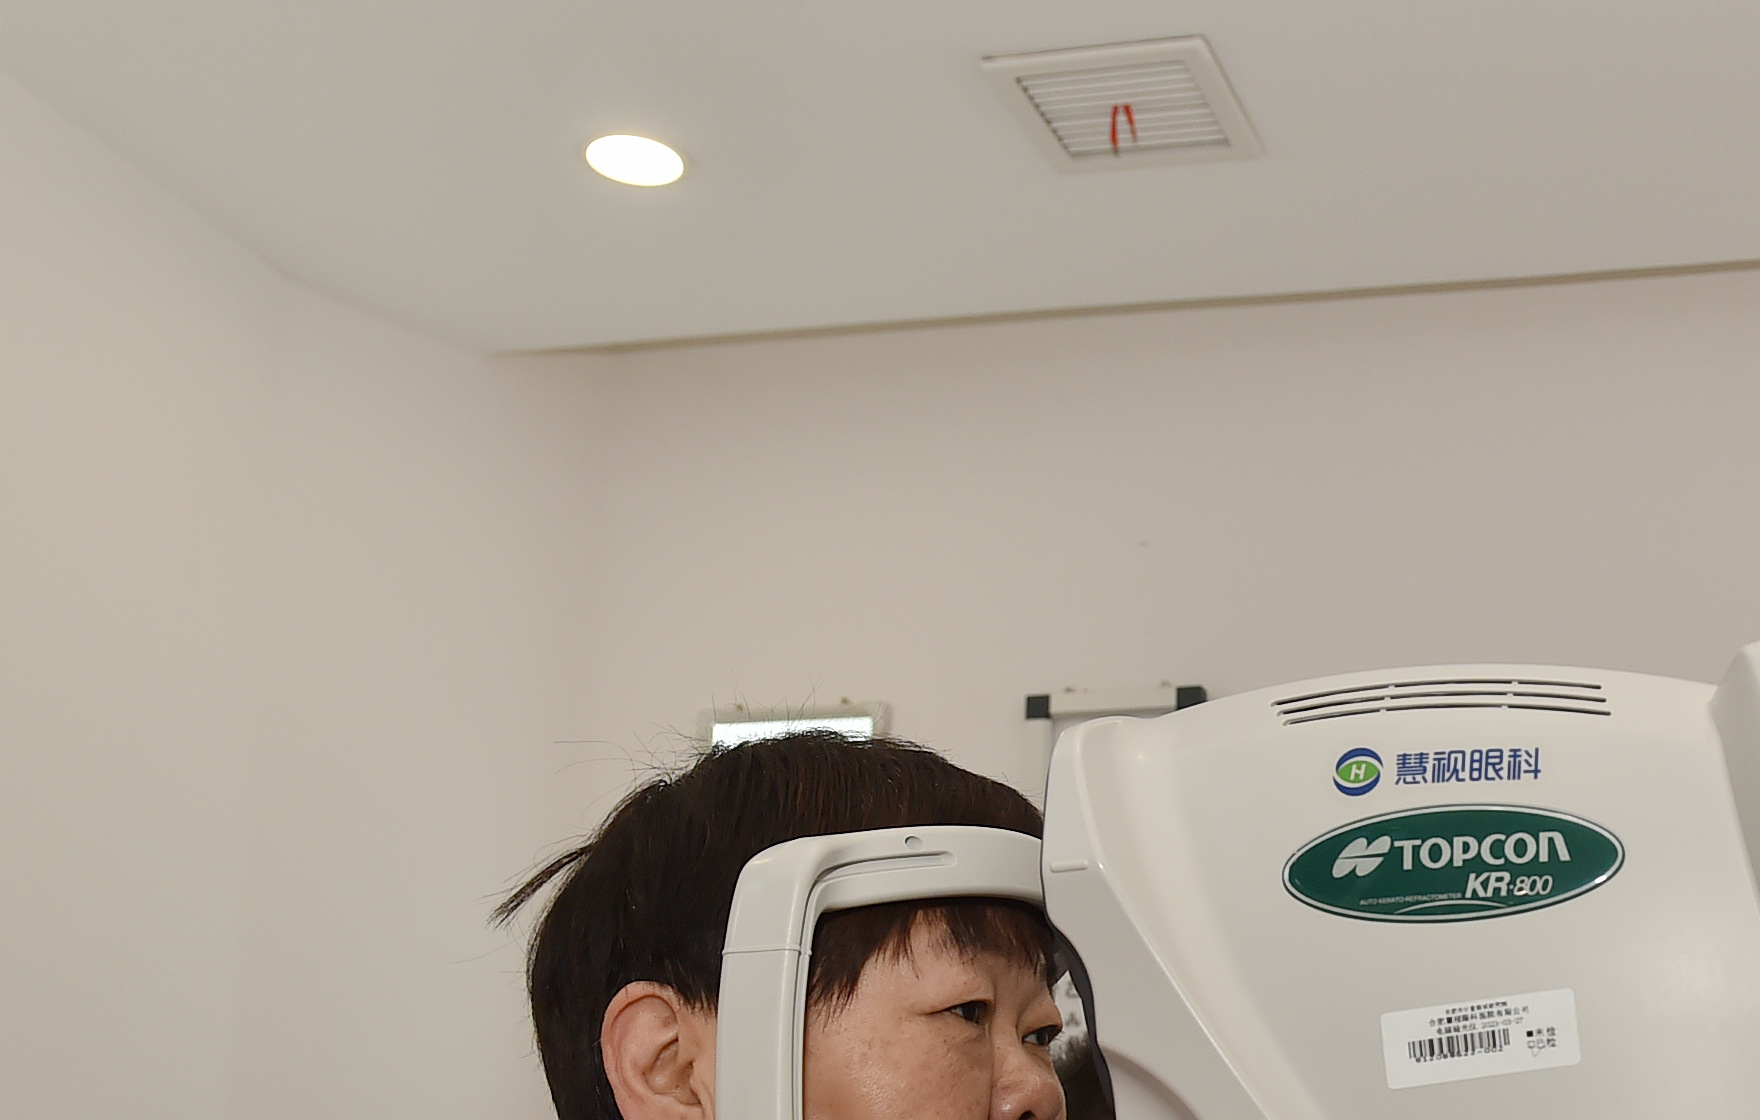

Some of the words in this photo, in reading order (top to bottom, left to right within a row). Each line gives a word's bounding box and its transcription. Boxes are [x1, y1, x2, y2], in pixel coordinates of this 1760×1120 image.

[1395, 747, 1541, 786] 慧视眼科
[1394, 831, 1571, 870] TOPCON
